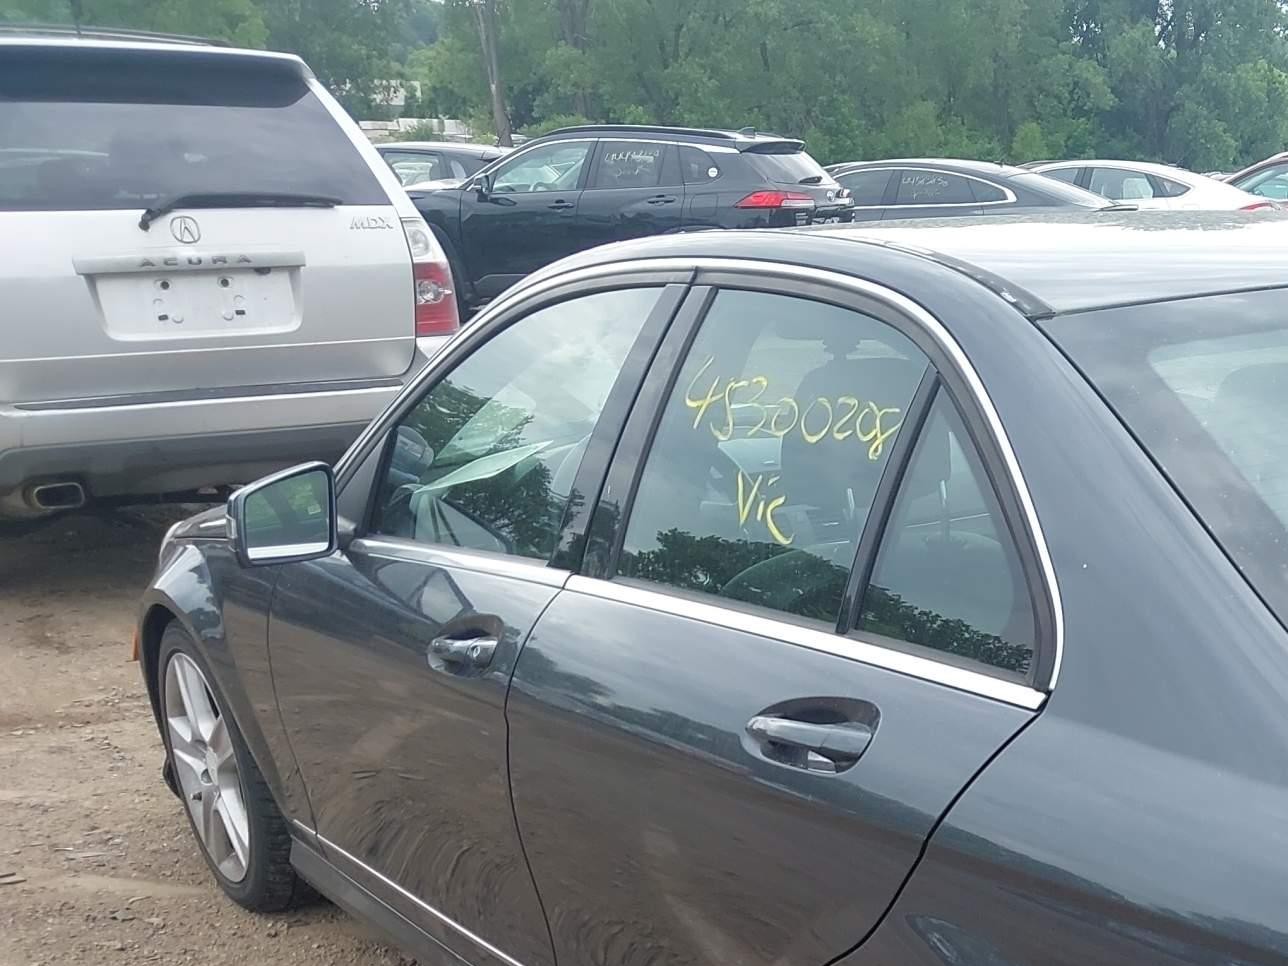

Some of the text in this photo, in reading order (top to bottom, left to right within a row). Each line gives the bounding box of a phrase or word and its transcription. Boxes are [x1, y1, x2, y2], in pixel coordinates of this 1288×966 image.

[349, 215, 394, 231] MDX
[138, 253, 254, 268] ACURA
[684, 354, 903, 461] 45300208
